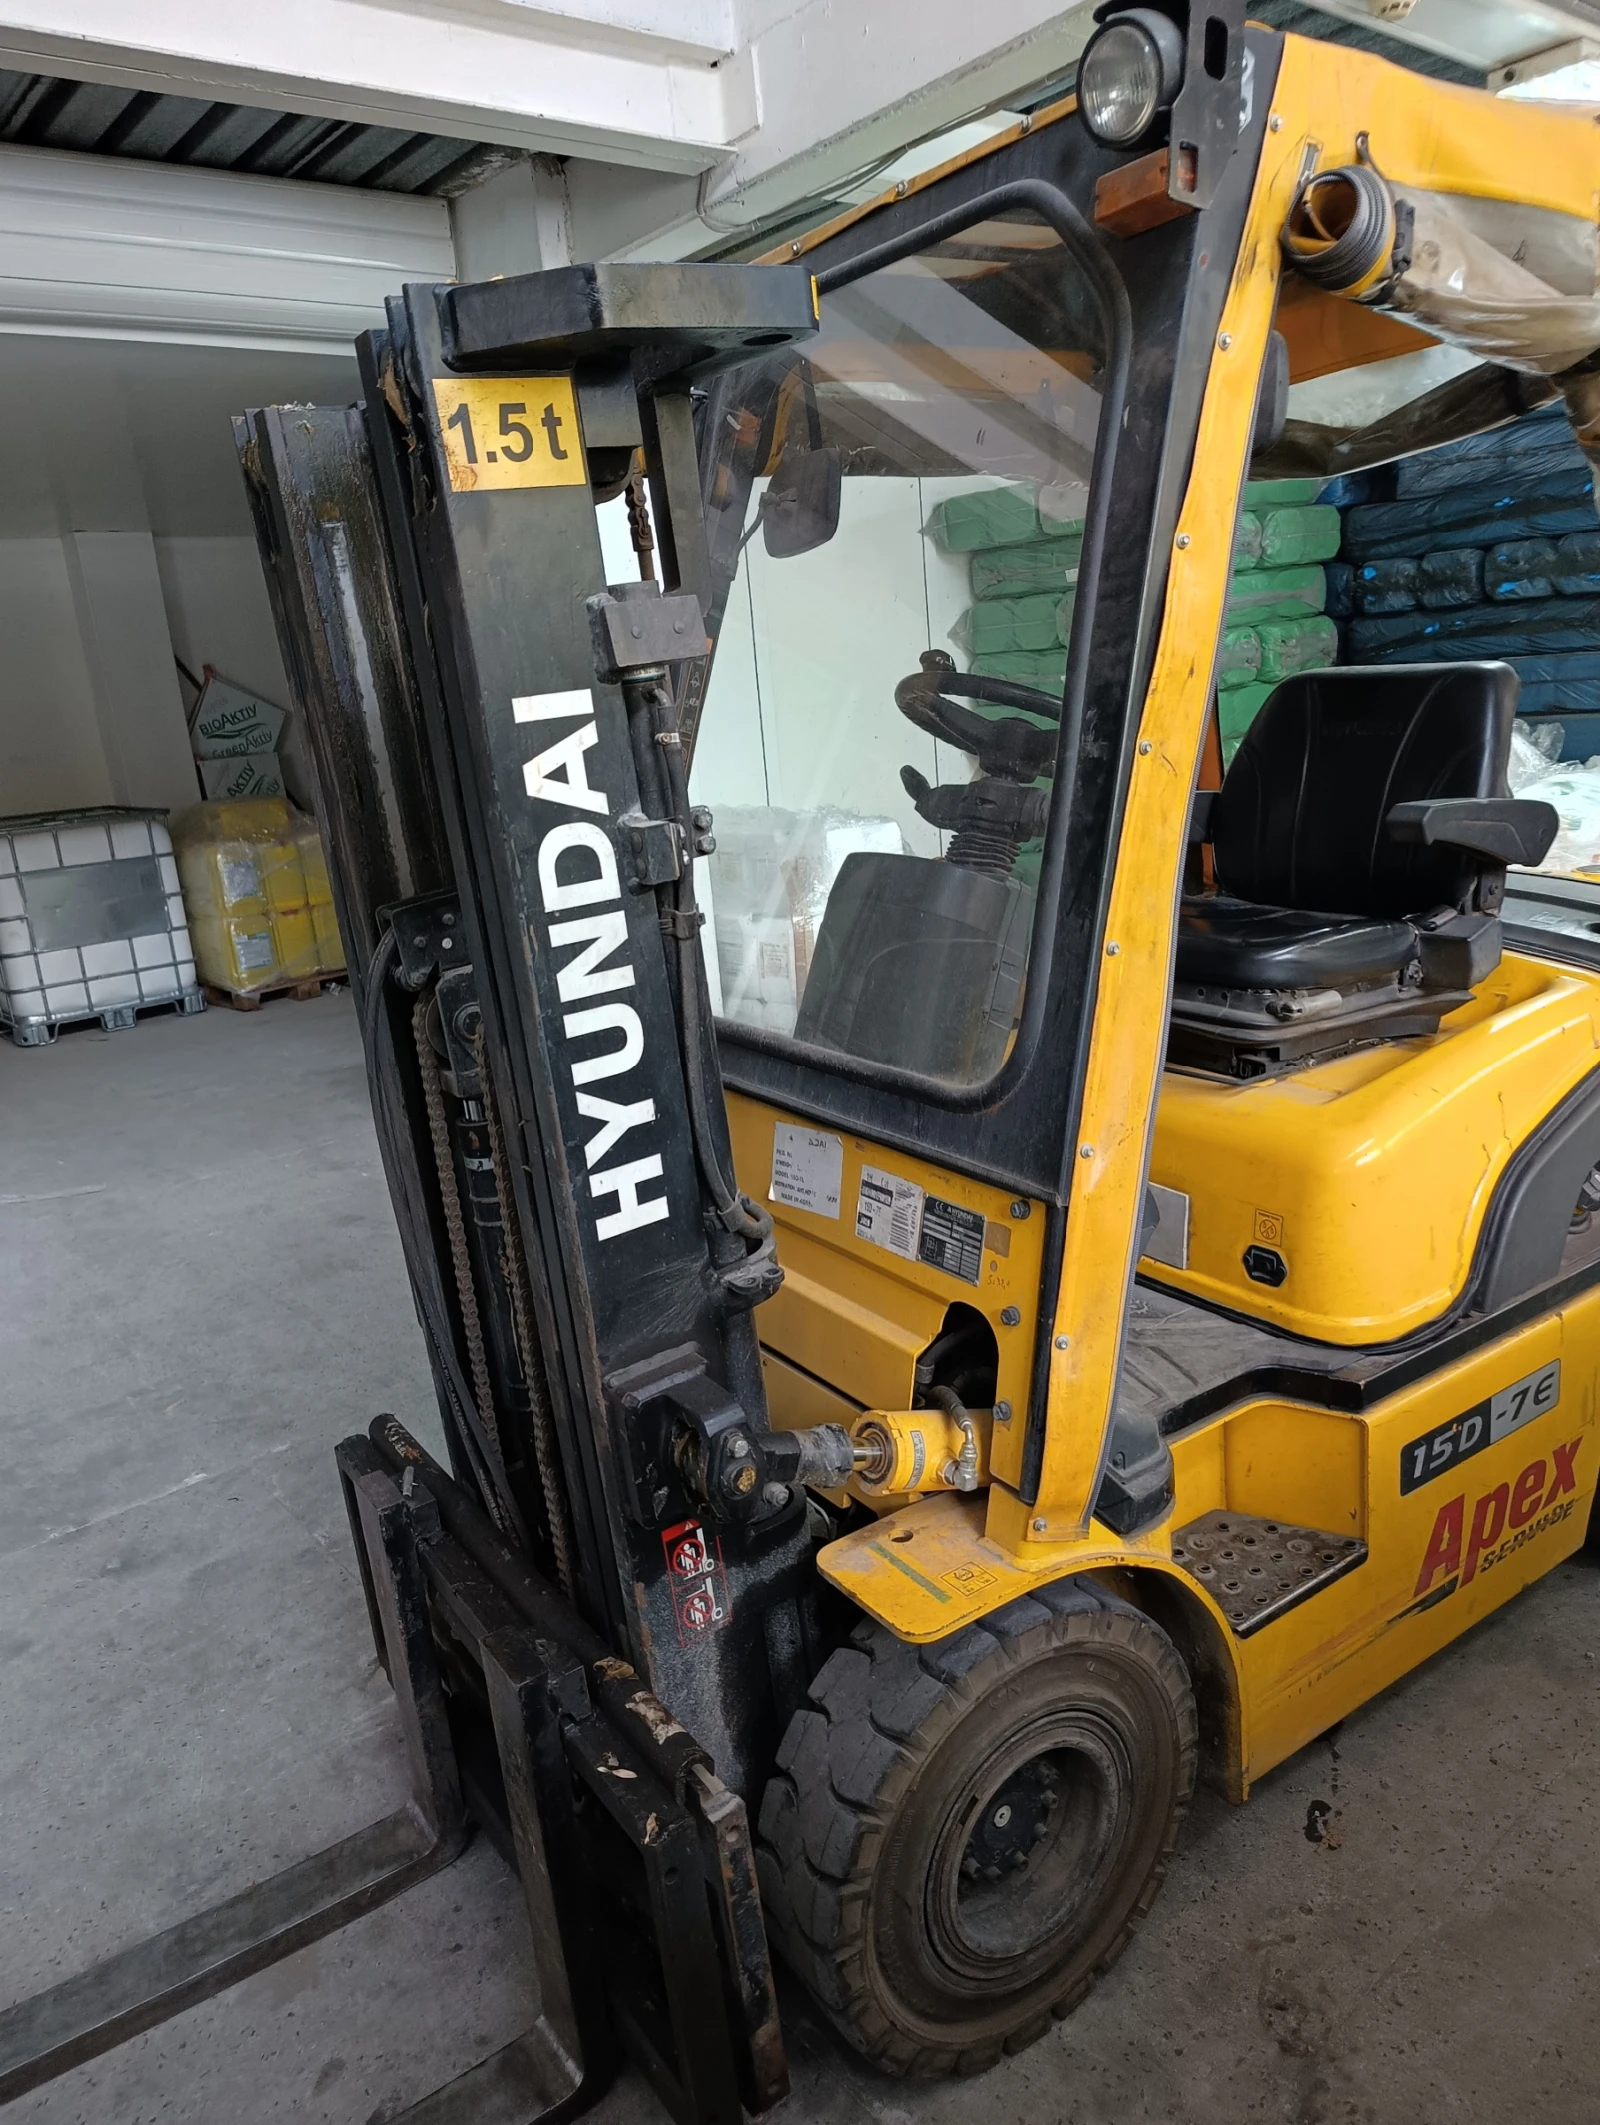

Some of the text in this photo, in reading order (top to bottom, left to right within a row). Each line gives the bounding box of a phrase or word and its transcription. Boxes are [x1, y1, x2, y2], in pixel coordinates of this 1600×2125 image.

[199, 703, 257, 737] BIOAKTIV
[512, 689, 669, 1242] HYUNDAI
[1412, 1435, 1584, 1598] Apex
